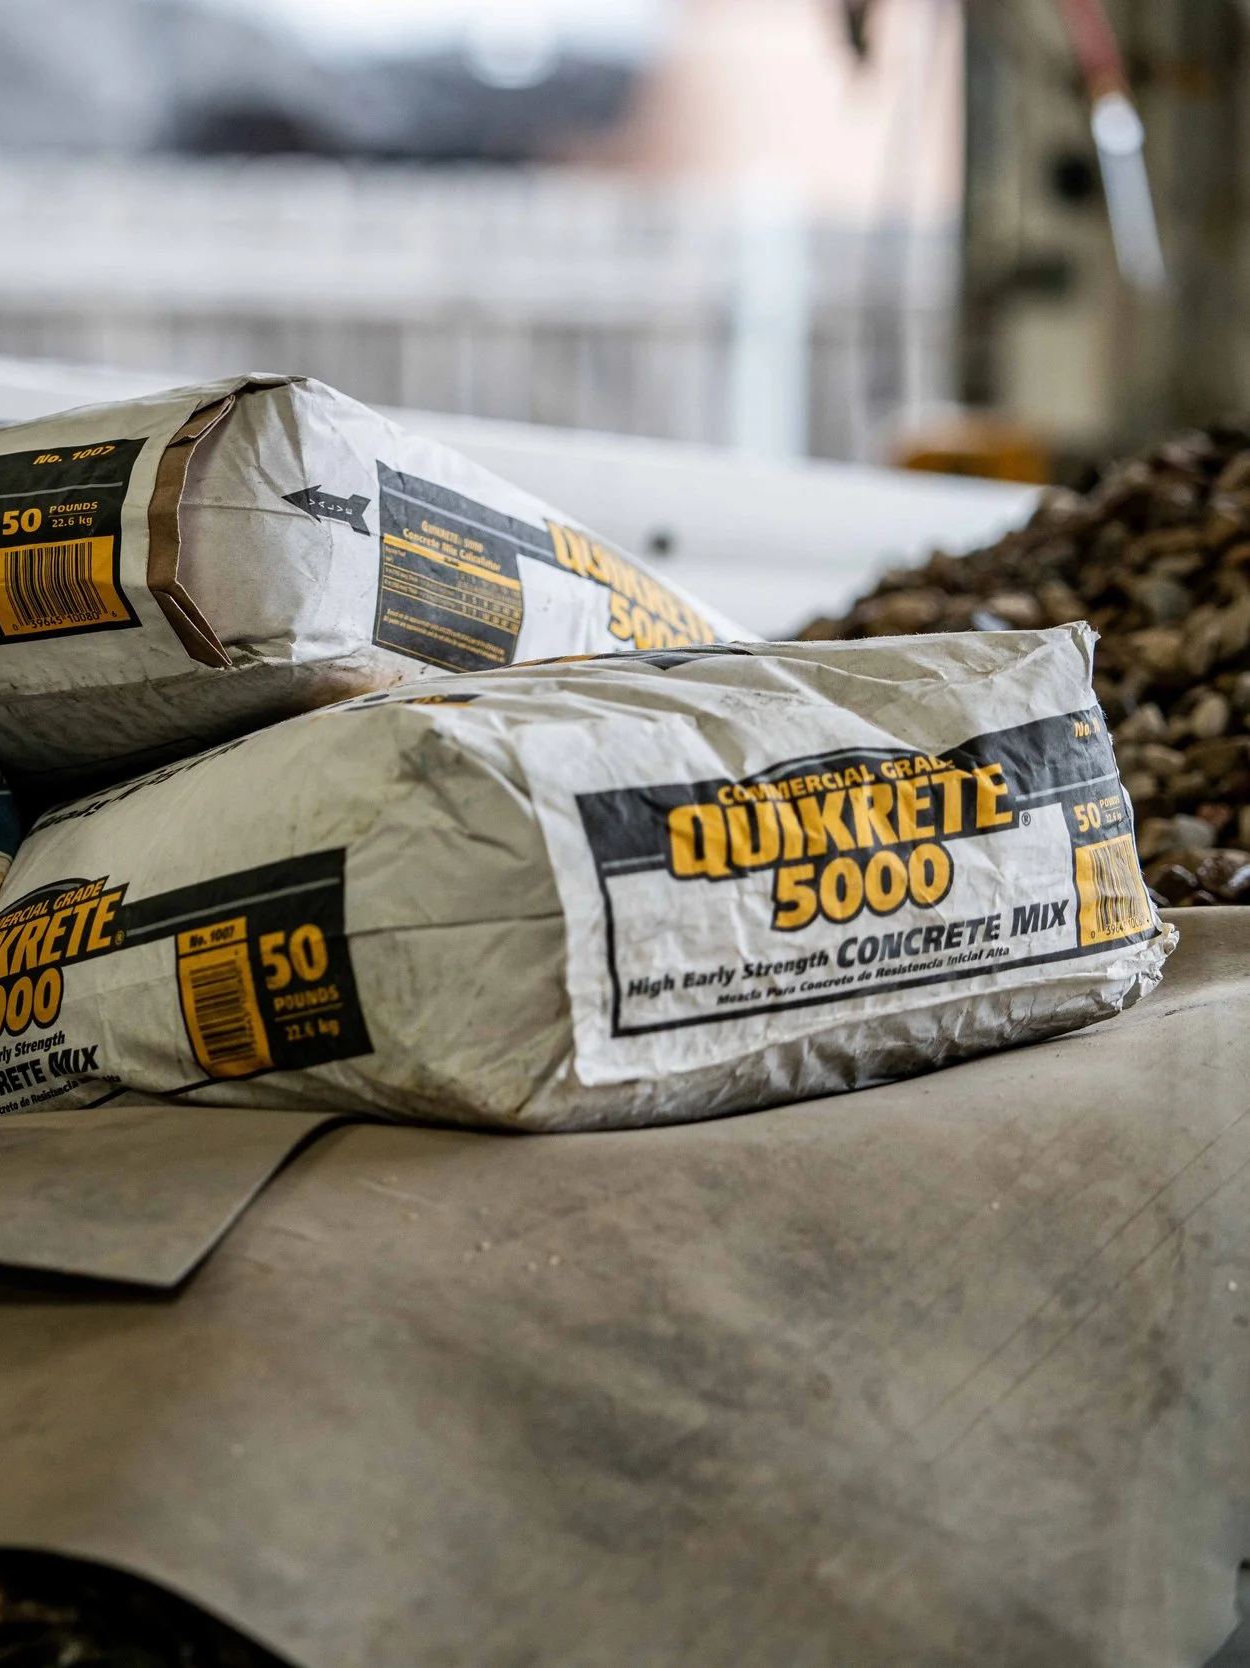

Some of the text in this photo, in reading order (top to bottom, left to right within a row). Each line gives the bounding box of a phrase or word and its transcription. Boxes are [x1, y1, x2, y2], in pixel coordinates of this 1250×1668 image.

[49, 501, 99, 513] POUNDS
[308, 498, 353, 515] VALVE
[2, 508, 42, 535] 50
[52, 515, 93, 528] 22.6 kg
[30, 615, 63, 629] 39645
[67, 611, 100, 623] 10080
[718, 765, 876, 806] COMMERCIAL
[1074, 801, 1100, 832] 50
[54, 879, 105, 910] GRADE
[775, 843, 949, 928] 5000
[259, 923, 328, 991] 50
[628, 899, 1070, 998] High Early Strength CONCRETE MIX
[766, 985, 795, 998] Para
[800, 973, 853, 992] Concreto
[857, 971, 872, 982] de
[875, 958, 943, 978] Resistencia
[947, 949, 983, 965] Inicial
[985, 946, 1010, 958] Alta
[273, 984, 340, 1012] POUNDS
[318, 1019, 340, 1037] kg
[15, 1031, 65, 1057] Strength
[48, 1045, 99, 1078] MIX
[20, 1097, 30, 1107] de
[31, 1081, 79, 1105] Resistencia
